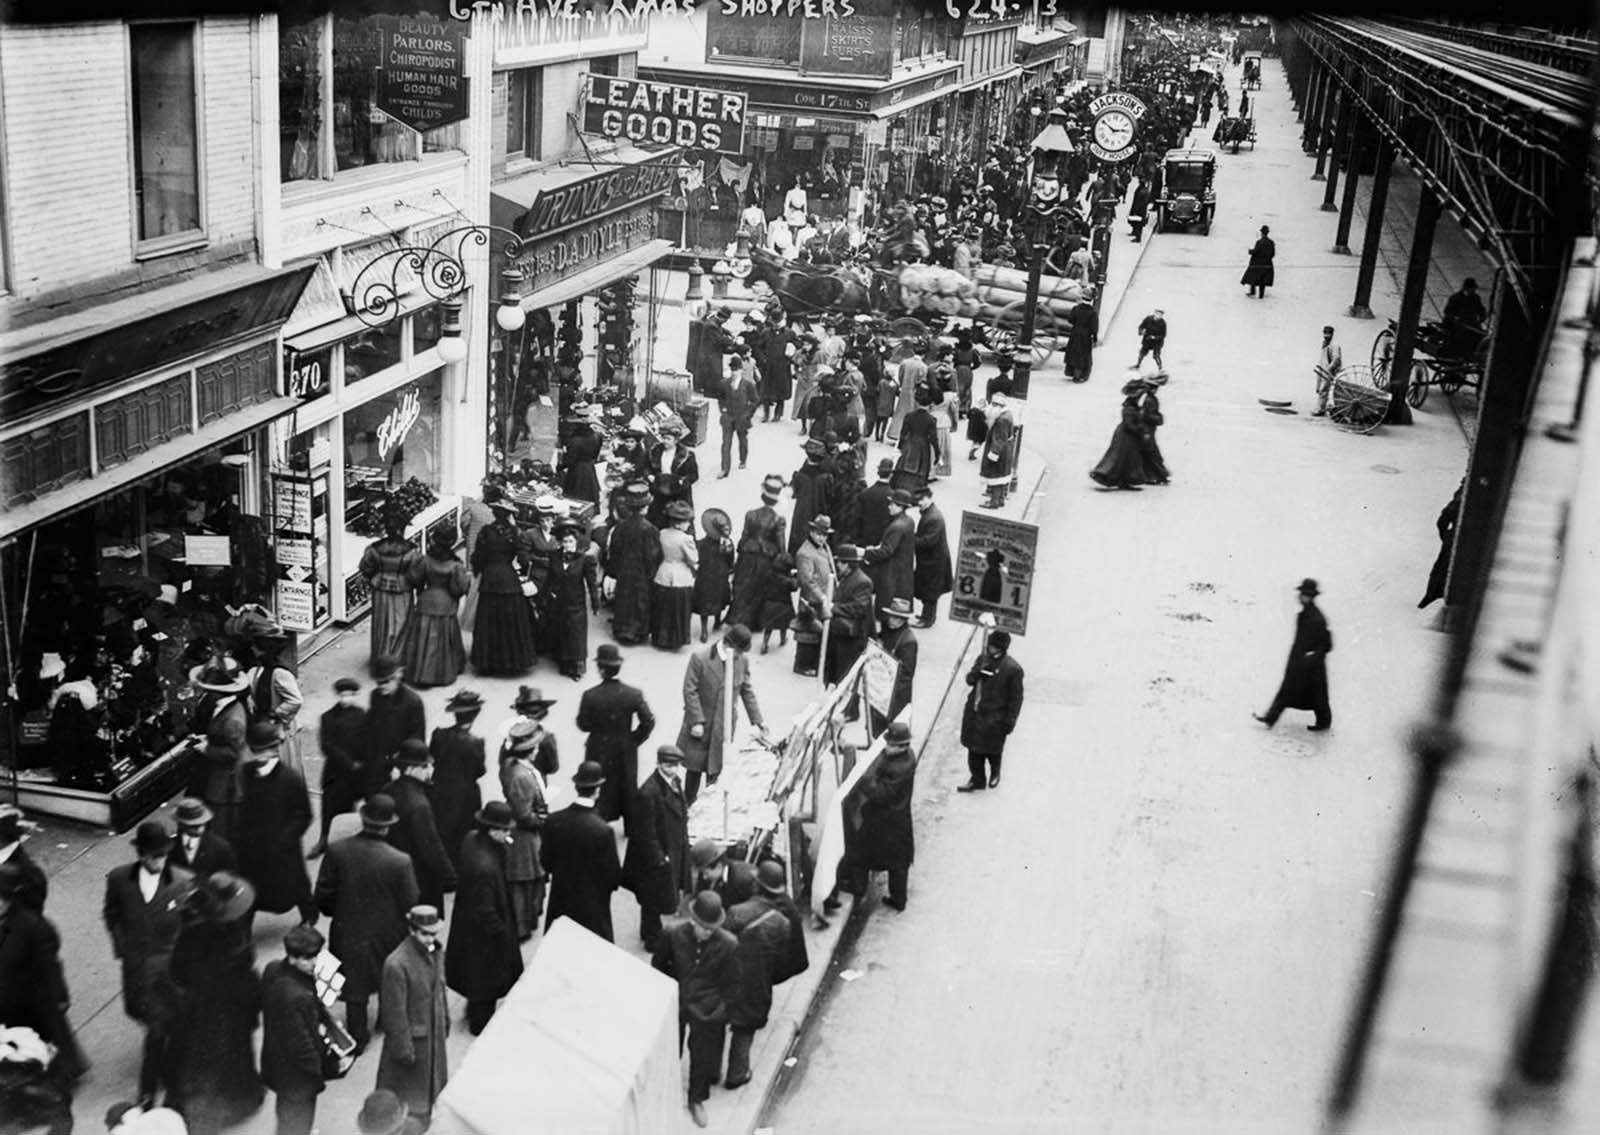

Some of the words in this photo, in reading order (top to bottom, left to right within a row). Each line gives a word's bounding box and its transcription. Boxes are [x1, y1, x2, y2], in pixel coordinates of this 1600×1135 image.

[399, 20, 448, 35] BEAUTY
[393, 33, 456, 53] PARLORS.
[831, 35, 872, 47] SKIRTS
[389, 50, 457, 69] CHIROPODIST
[388, 69, 427, 84] HUMAN
[430, 74, 458, 90] HAIR
[403, 83, 441, 95] GOODS
[586, 76, 743, 123] LEATHER
[602, 110, 723, 151] GOODS
[529, 173, 620, 233] TRUNKS
[292, 361, 321, 397] 270
